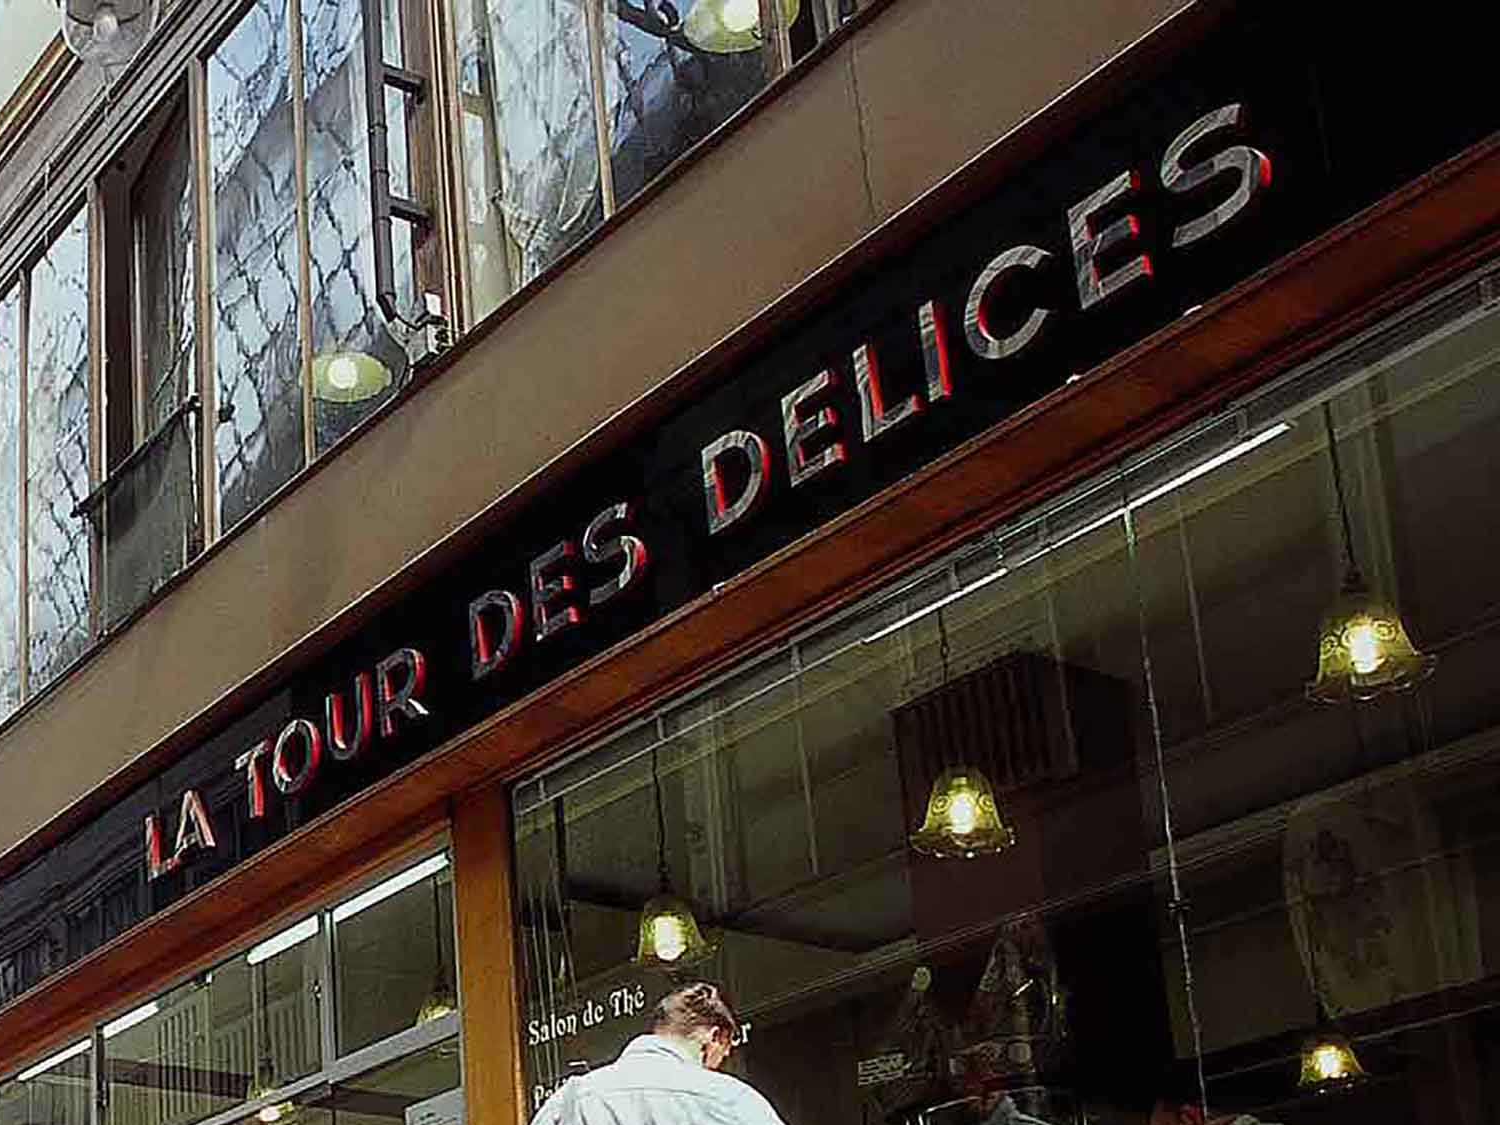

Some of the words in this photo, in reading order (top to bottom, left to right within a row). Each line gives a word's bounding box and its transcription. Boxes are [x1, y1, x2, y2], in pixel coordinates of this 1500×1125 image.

[145, 789, 216, 882] LA
[234, 646, 429, 819] TOUR
[469, 502, 646, 680] DES
[700, 102, 1273, 536] DELICES
[528, 1014, 578, 1046] Salon
[582, 1001, 605, 1027] de
[610, 984, 645, 1018] Thé
